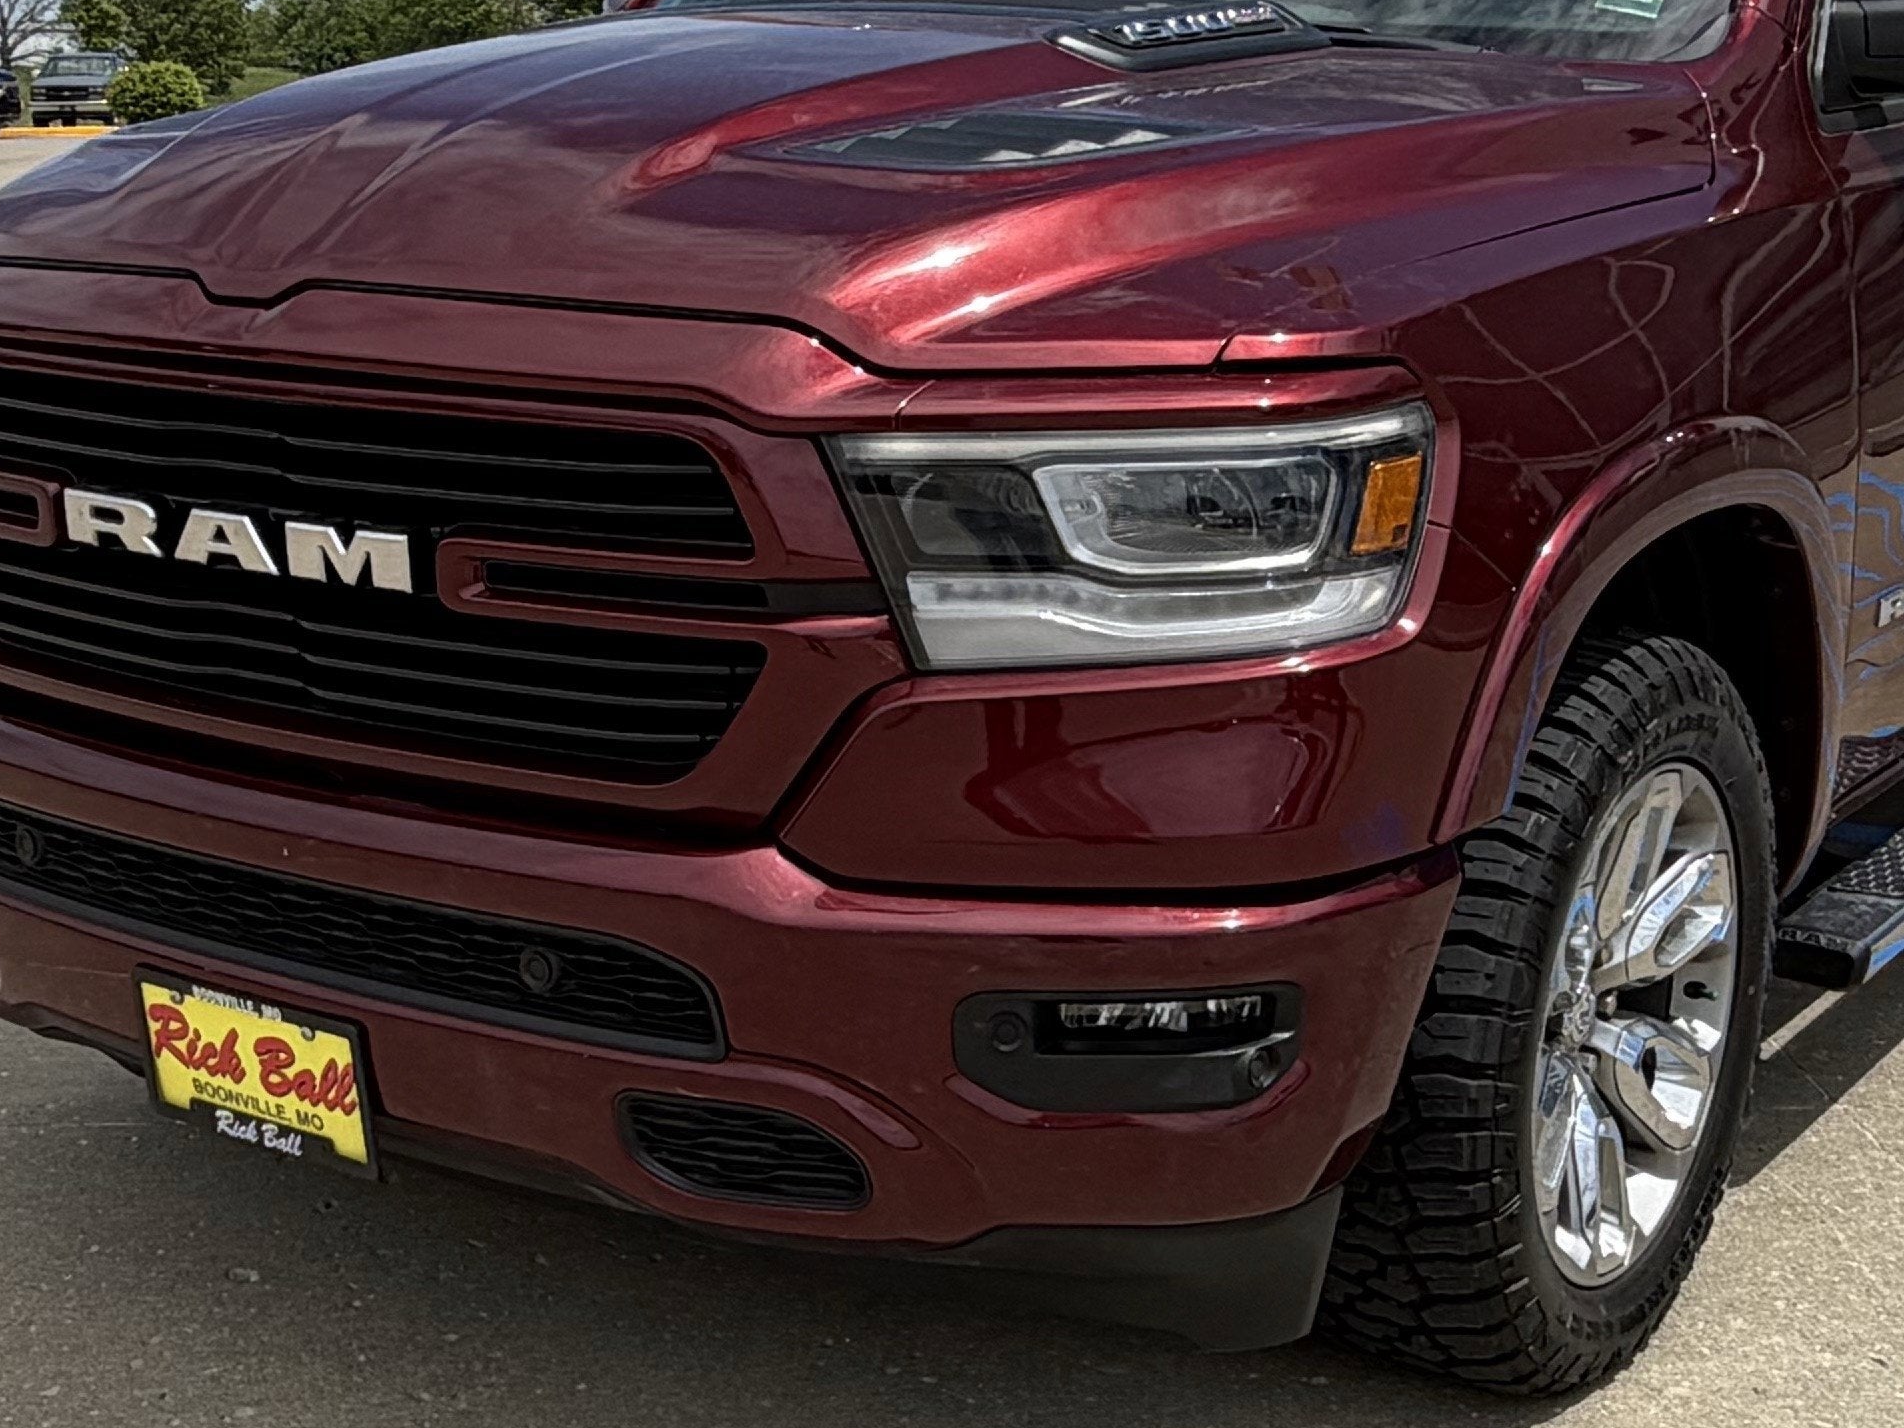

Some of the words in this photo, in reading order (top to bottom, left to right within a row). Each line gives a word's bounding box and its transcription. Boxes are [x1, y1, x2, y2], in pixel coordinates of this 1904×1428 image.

[1114, 9, 1235, 43] 1500
[63, 487, 414, 594] RAM
[148, 1003, 247, 1085] Rick
[253, 1036, 359, 1117] Ball
[214, 1109, 260, 1144] Rick
[261, 1123, 304, 1157] Ball
[295, 1108, 325, 1132] MO
